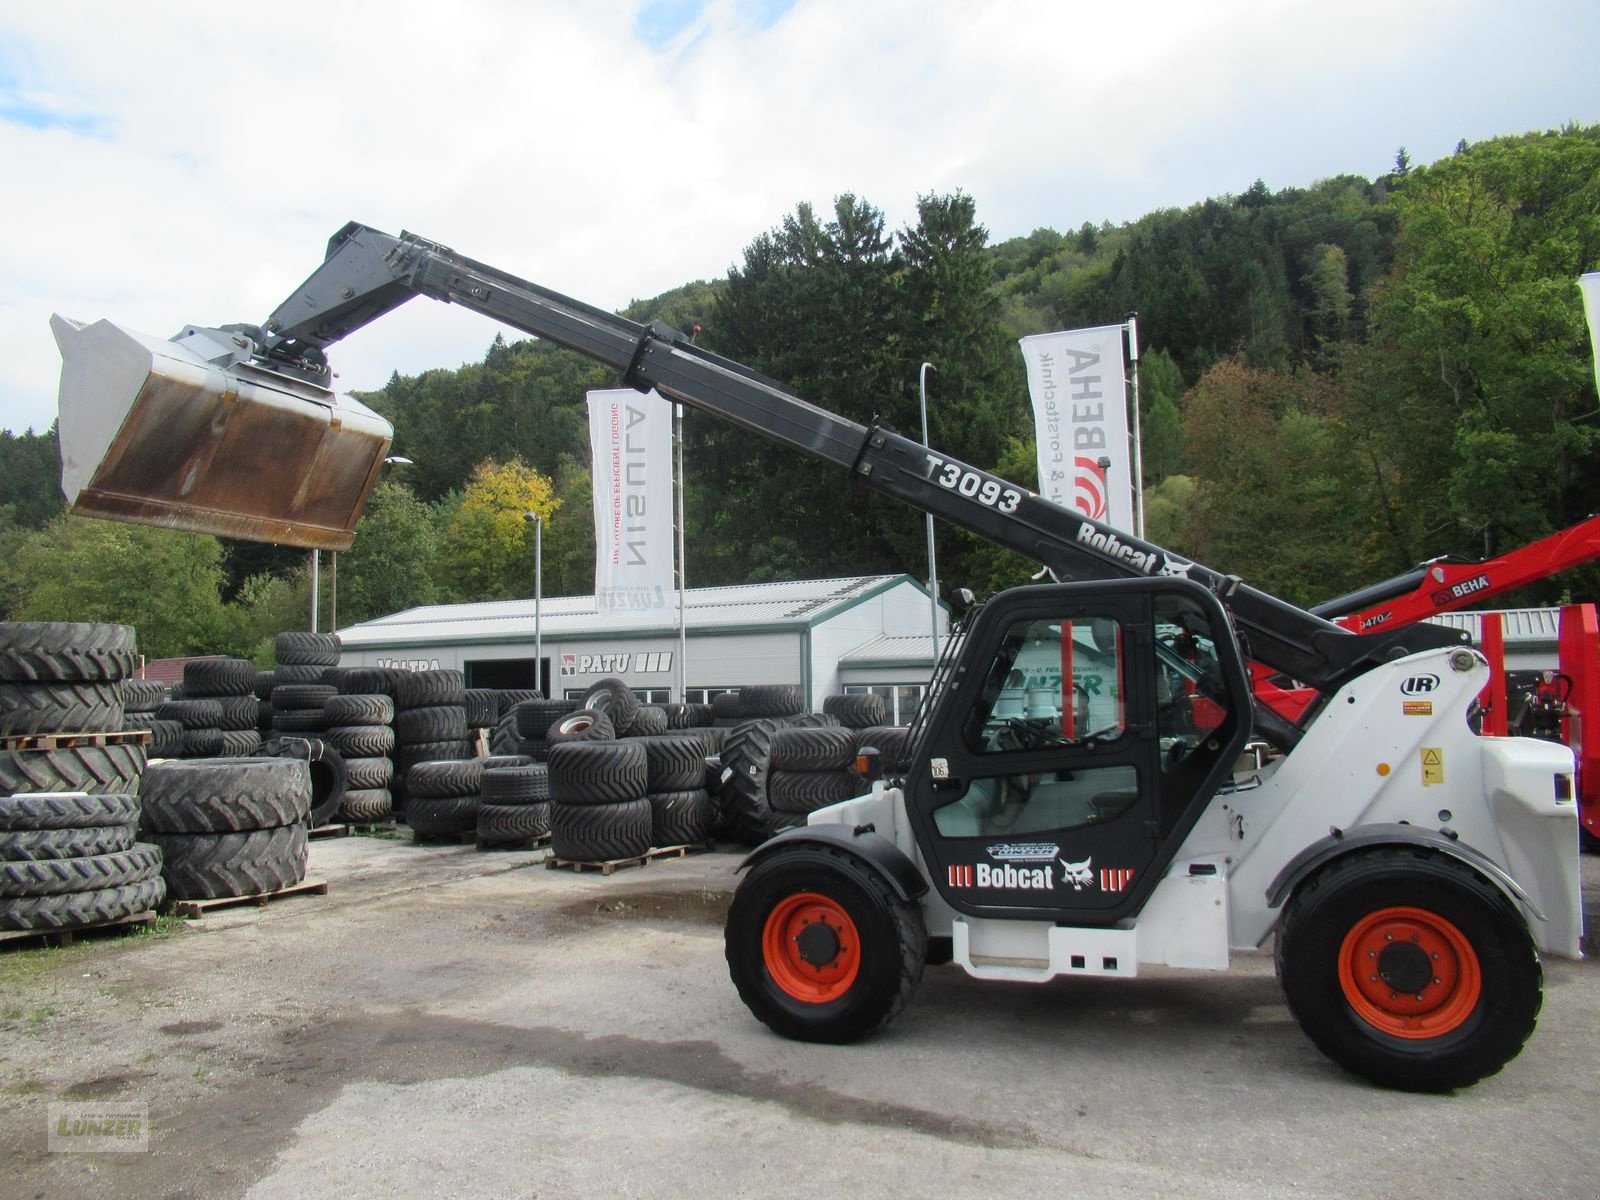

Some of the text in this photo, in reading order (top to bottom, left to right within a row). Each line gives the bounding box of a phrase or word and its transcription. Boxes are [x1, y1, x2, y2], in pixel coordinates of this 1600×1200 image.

[926, 454, 1021, 514] T3093
[1076, 522, 1157, 575] Bobcat
[1452, 576, 1489, 597] BEHA
[578, 653, 631, 673] PATU
[1406, 677, 1434, 692] IR
[976, 863, 1054, 890] Bobcat
